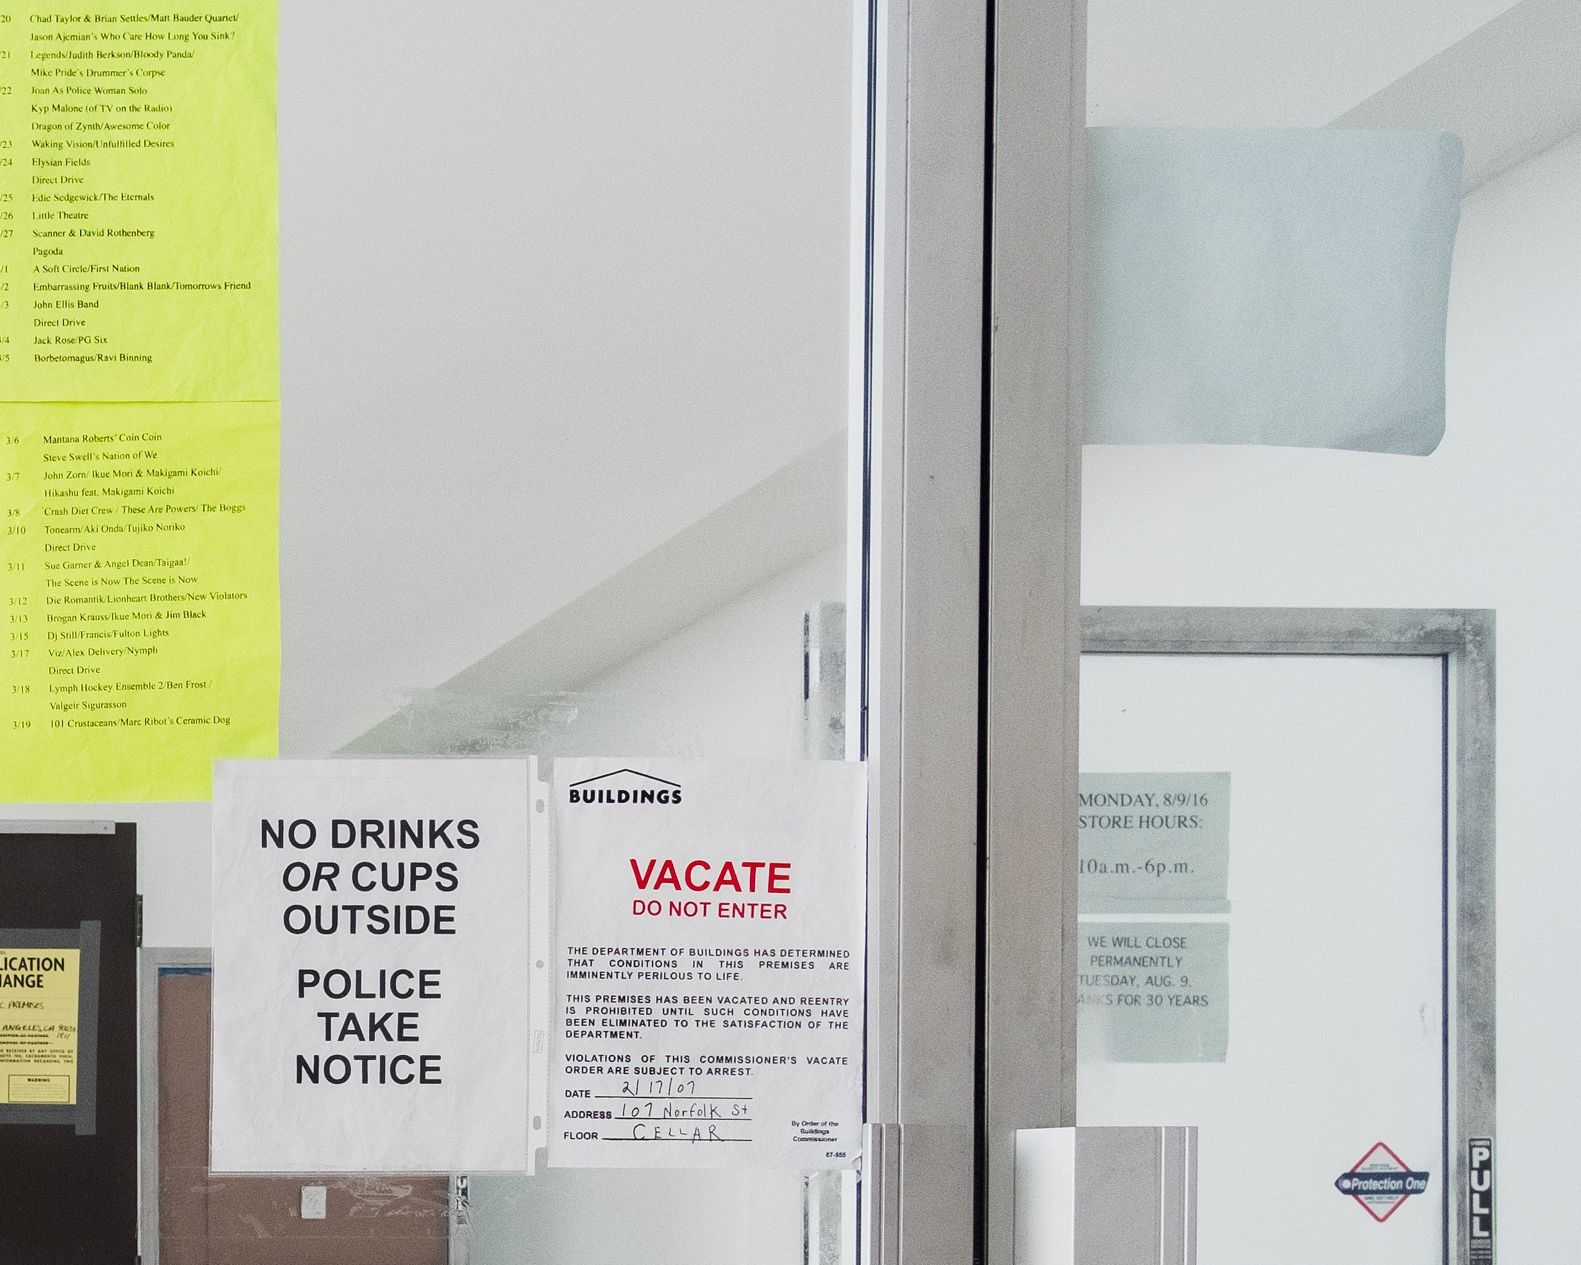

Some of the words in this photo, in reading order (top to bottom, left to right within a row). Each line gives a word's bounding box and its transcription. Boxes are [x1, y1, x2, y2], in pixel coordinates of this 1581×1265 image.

[29, 14, 52, 23] Chad
[53, 14, 82, 25] Taylor
[83, 14, 92, 23] &
[94, 14, 118, 23] Brian
[173, 13, 203, 23] Bauder
[30, 32, 54, 42] Jason
[100, 32, 121, 41] Who
[144, 32, 165, 41] How
[167, 31, 190, 43] Long
[191, 31, 209, 41] You
[31, 86, 50, 95] Joan
[52, 86, 64, 95] As
[65, 85, 92, 95] Police
[93, 86, 126, 95] Woman
[128, 86, 148, 95] Solo
[32, 300, 53, 310] John
[55, 300, 75, 309] Ellis
[77, 299, 100, 309] Band
[5, 435, 20, 445] 3/6
[118, 432, 140, 443] Coin
[141, 432, 162, 442] Coin
[43, 453, 67, 463] Steve
[102, 451, 131, 461] Nation
[132, 450, 143, 460] of
[144, 450, 158, 460] We
[12, 720, 32, 730] 3/19
[50, 719, 64, 729] 101
[175, 715, 211, 725] Ceramic
[213, 715, 231, 726] Dog
[569, 789, 682, 805] BUILDINGS
[1078, 792, 1159, 808] MONDAY,
[1163, 793, 1209, 807] 8/9/16
[1078, 814, 1134, 830] STORE
[1138, 814, 1203, 829] HOURS:
[261, 818, 317, 850] NO
[331, 818, 480, 850] DRINKS
[282, 861, 340, 892] OR
[351, 861, 459, 893] CUPS
[629, 858, 792, 894] VACATE
[632, 899, 662, 917] DO
[669, 900, 712, 918] NOT
[718, 902, 788, 920] ENTER
[283, 904, 456, 935] OUTSIDE
[1087, 935, 1108, 948] WE
[1111, 935, 1143, 949] WILL
[1145, 935, 1188, 950] CLOSE
[567, 946, 588, 956] THE
[591, 946, 667, 957] DEPARTMENT
[669, 947, 685, 957] OF
[689, 947, 750, 958] BUILDINGS
[753, 948, 776, 958] HAS
[779, 948, 850, 959] DETERMINED
[567, 958, 595, 967] THAT
[609, 958, 678, 969] CONDITIONS
[692, 960, 704, 969] IN
[718, 960, 744, 969] THIS
[758, 960, 815, 970] PREMISES
[828, 961, 849, 971] ARE
[1090, 954, 1183, 968] PERMANENTLY
[566, 970, 634, 980] IMMINENTLY
[637, 971, 693, 981] PERILOUS
[697, 972, 712, 981] TO
[715, 972, 743, 981] LIFE.
[298, 968, 442, 1000] POLICE
[1116, 993, 1141, 1007] FOR
[1145, 994, 1164, 1007] 30
[1167, 994, 1209, 1008] YEARS
[316, 1011, 420, 1042] TAKE
[565, 1053, 632, 1063] VIOLATIONS
[640, 1054, 656, 1064] OF
[665, 1054, 691, 1064] THIS
[699, 1055, 797, 1065] COMMISSIONER'S
[806, 1056, 848, 1066] VACATE
[296, 1054, 442, 1085] NOTICE
[564, 1065, 604, 1075] ORDER
[606, 1066, 630, 1075] ARE
[633, 1066, 685, 1076] SUBJECT
[688, 1066, 703, 1076] TO
[706, 1067, 754, 1076] ARREST.
[564, 1089, 591, 1099] DATE
[563, 1110, 613, 1120] ADDRESS
[622, 1103, 653, 1118] 107
[563, 1131, 599, 1141] FLOOR
[632, 1123, 726, 1144] CELLAR
[1350, 1177, 1404, 1191] Protection
[1405, 1176, 1426, 1190] One
[1470, 1147, 1491, 1238] PULL
